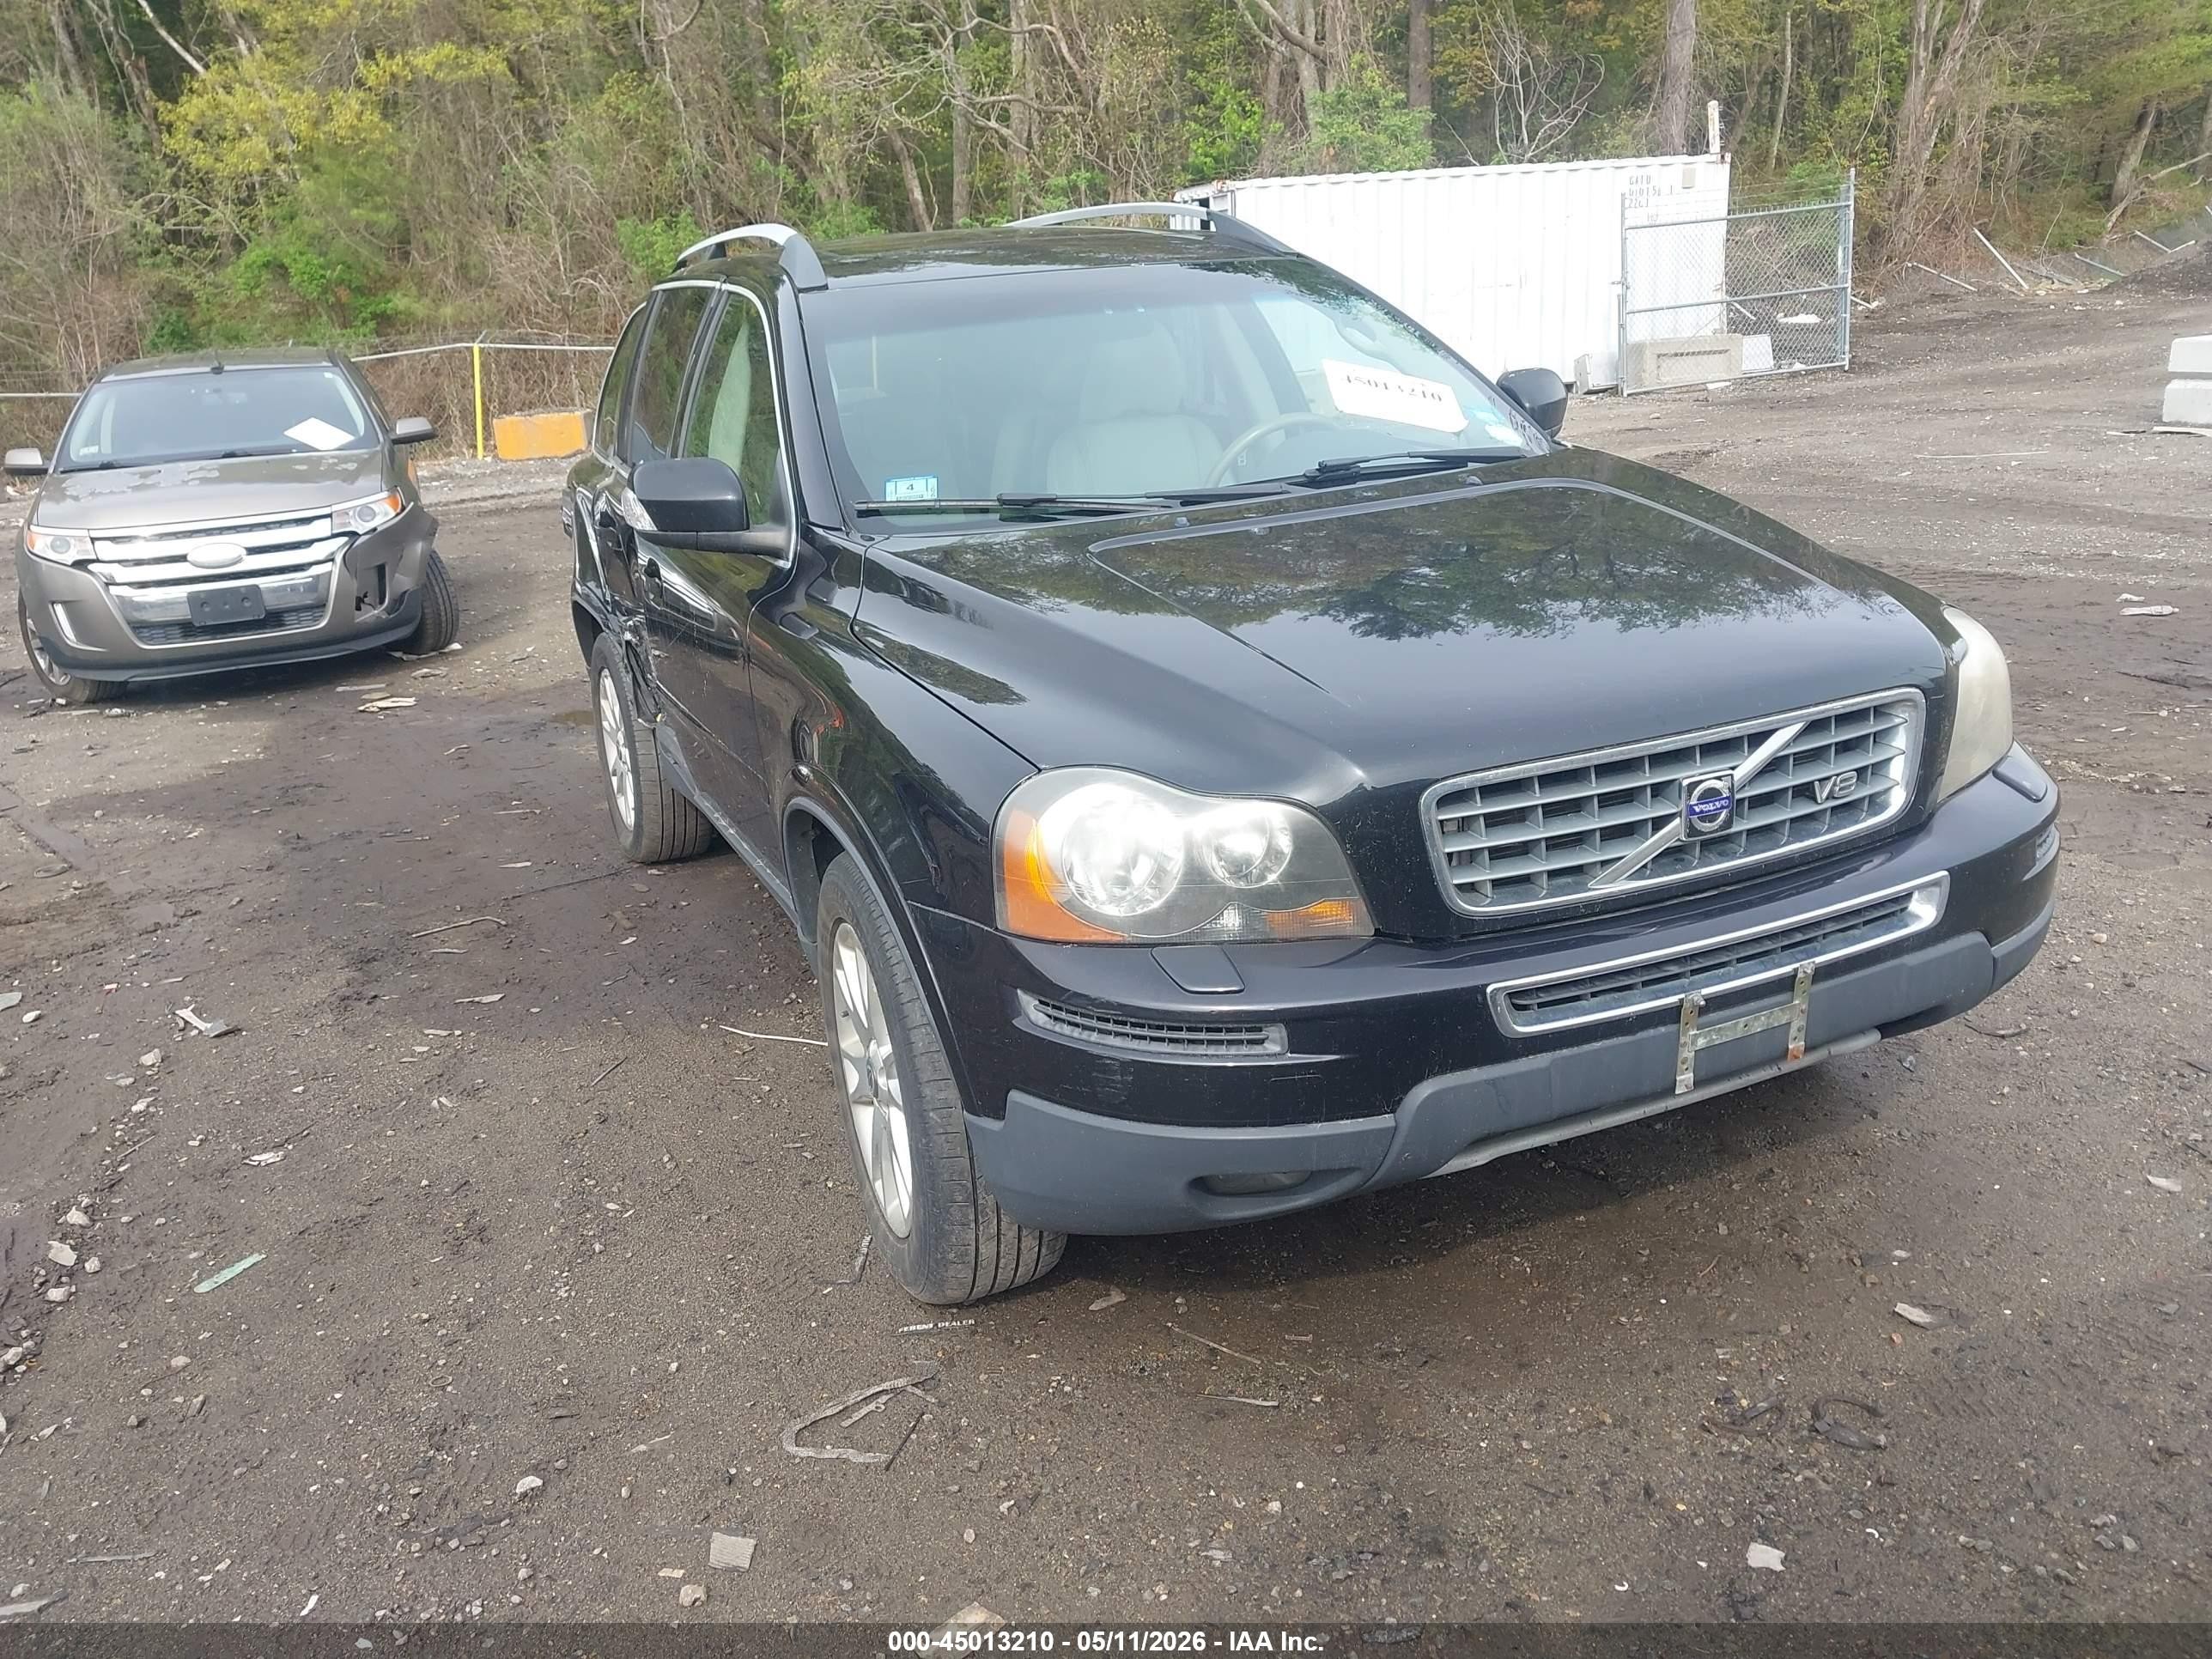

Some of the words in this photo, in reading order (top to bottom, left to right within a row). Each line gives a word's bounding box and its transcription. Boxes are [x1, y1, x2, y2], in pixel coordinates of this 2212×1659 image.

[906, 483, 915, 491] 4
[1814, 771, 1858, 804] V8
[1692, 799, 1729, 812] VOLVO
[938, 1319, 975, 1328] DEALER
